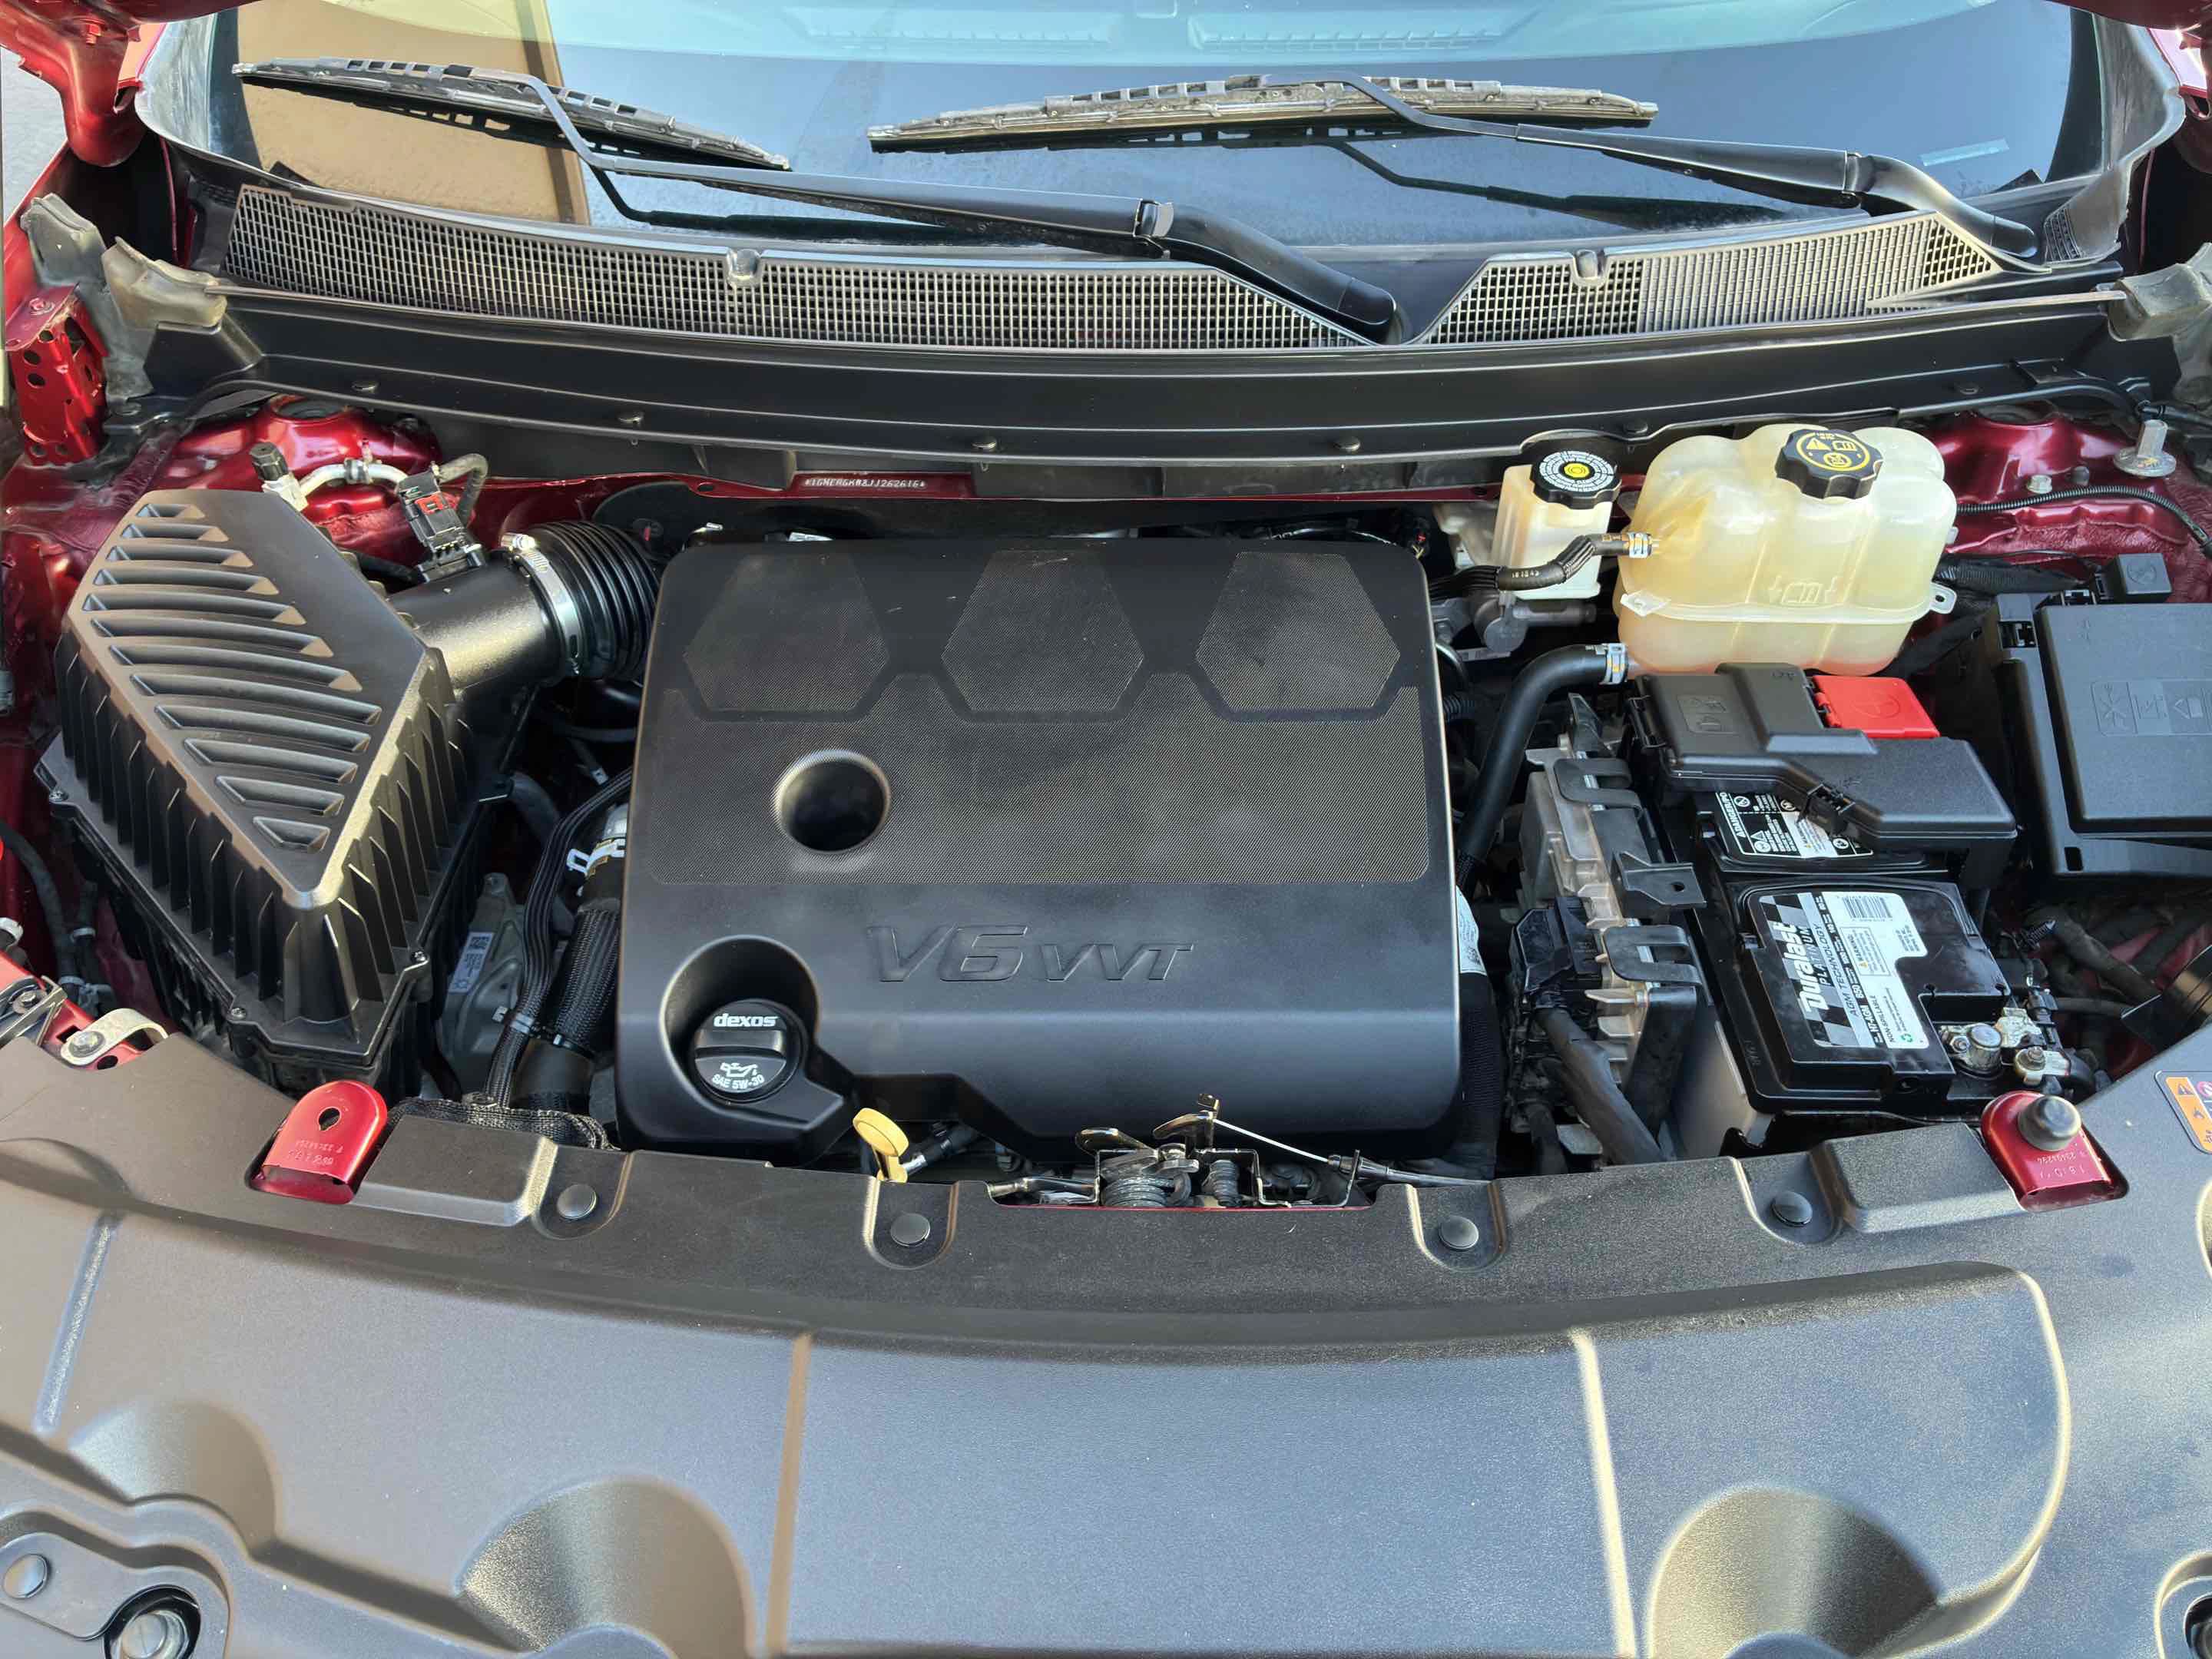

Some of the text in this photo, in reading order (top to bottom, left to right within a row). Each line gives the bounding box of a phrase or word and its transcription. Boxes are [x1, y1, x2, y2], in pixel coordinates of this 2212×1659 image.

[866, 924, 1194, 982] V6 VVT
[1773, 921, 1830, 1012] Duralast
[1800, 926, 1832, 986] PLATINUM
[1813, 924, 1843, 990] TECHNOLOGY
[713, 1012, 780, 1028] dexos
[1843, 991, 1859, 1017] AGM
[712, 1074, 765, 1089] SAE 5W-30
